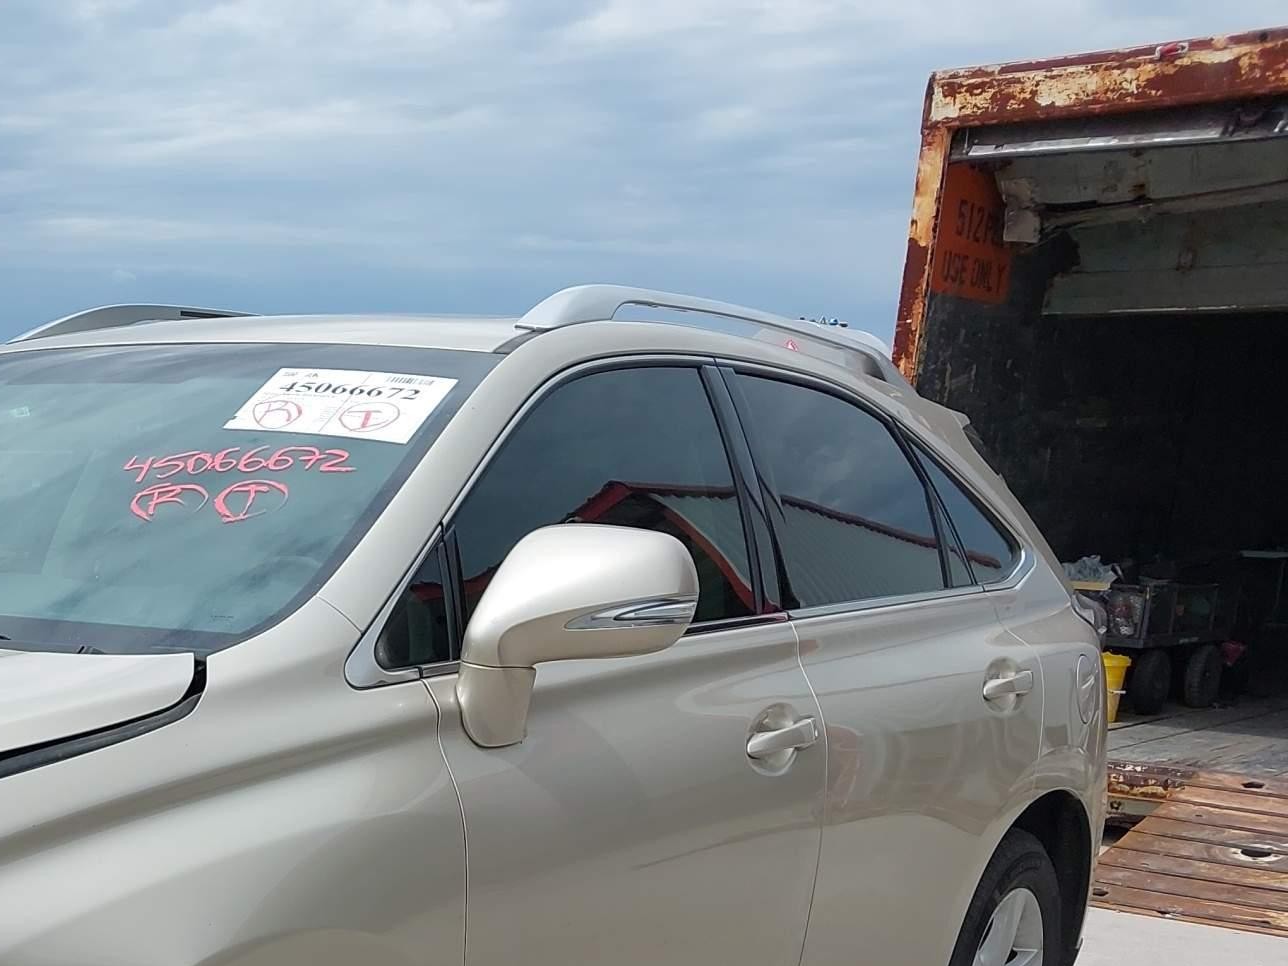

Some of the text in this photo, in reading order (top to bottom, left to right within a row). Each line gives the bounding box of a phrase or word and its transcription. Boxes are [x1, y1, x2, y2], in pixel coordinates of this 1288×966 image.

[943, 250, 1009, 294] USE ONLY
[279, 380, 421, 401] 45066672
[123, 445, 357, 483] 45066672
